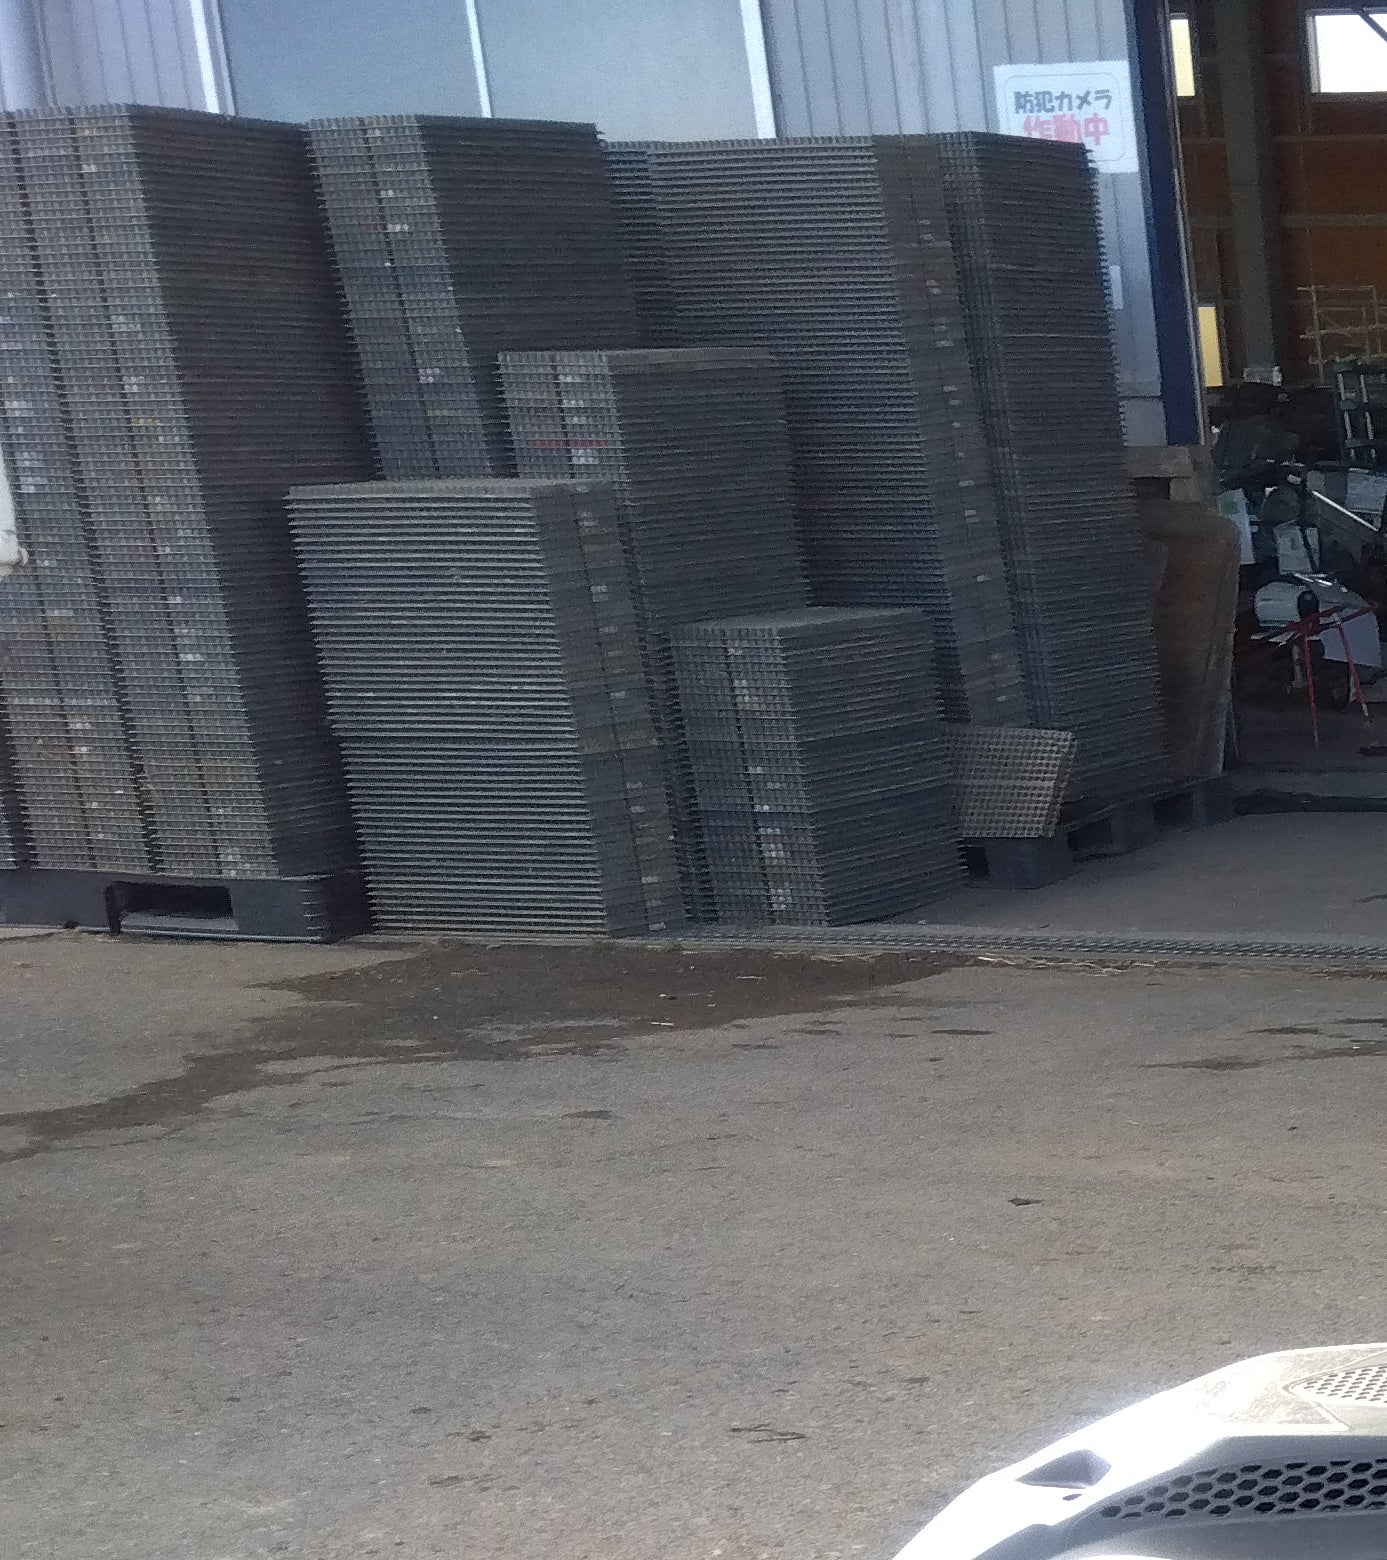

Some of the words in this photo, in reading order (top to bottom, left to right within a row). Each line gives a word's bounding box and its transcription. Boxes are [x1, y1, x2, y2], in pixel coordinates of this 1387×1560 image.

[1013, 89, 1112, 114] 防犯カメラ
[1022, 112, 1110, 146] 作動中
